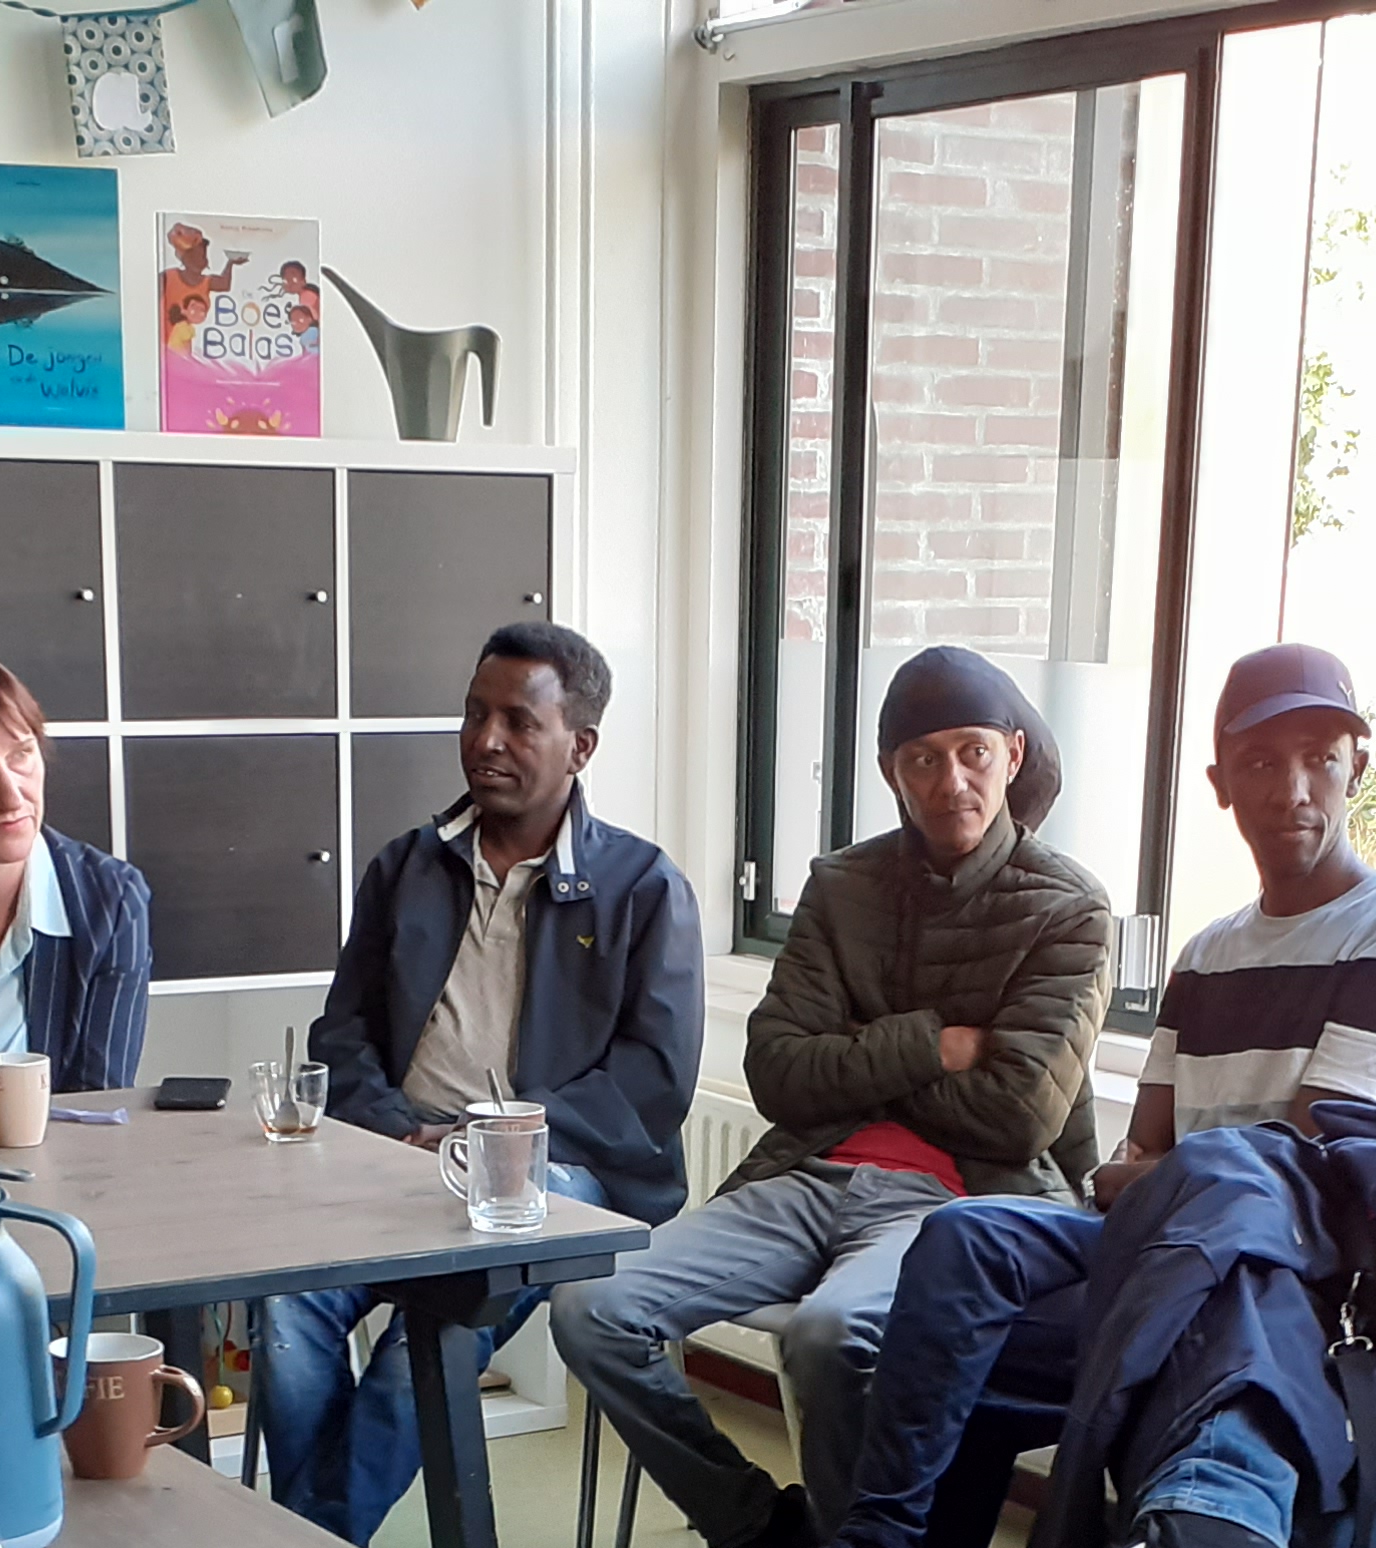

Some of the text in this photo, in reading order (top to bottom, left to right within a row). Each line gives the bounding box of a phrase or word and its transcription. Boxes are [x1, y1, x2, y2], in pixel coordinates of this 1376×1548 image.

[7, 344, 39, 366] De
[202, 327, 294, 361] Balas
[85, 1376, 125, 1400] FIE
